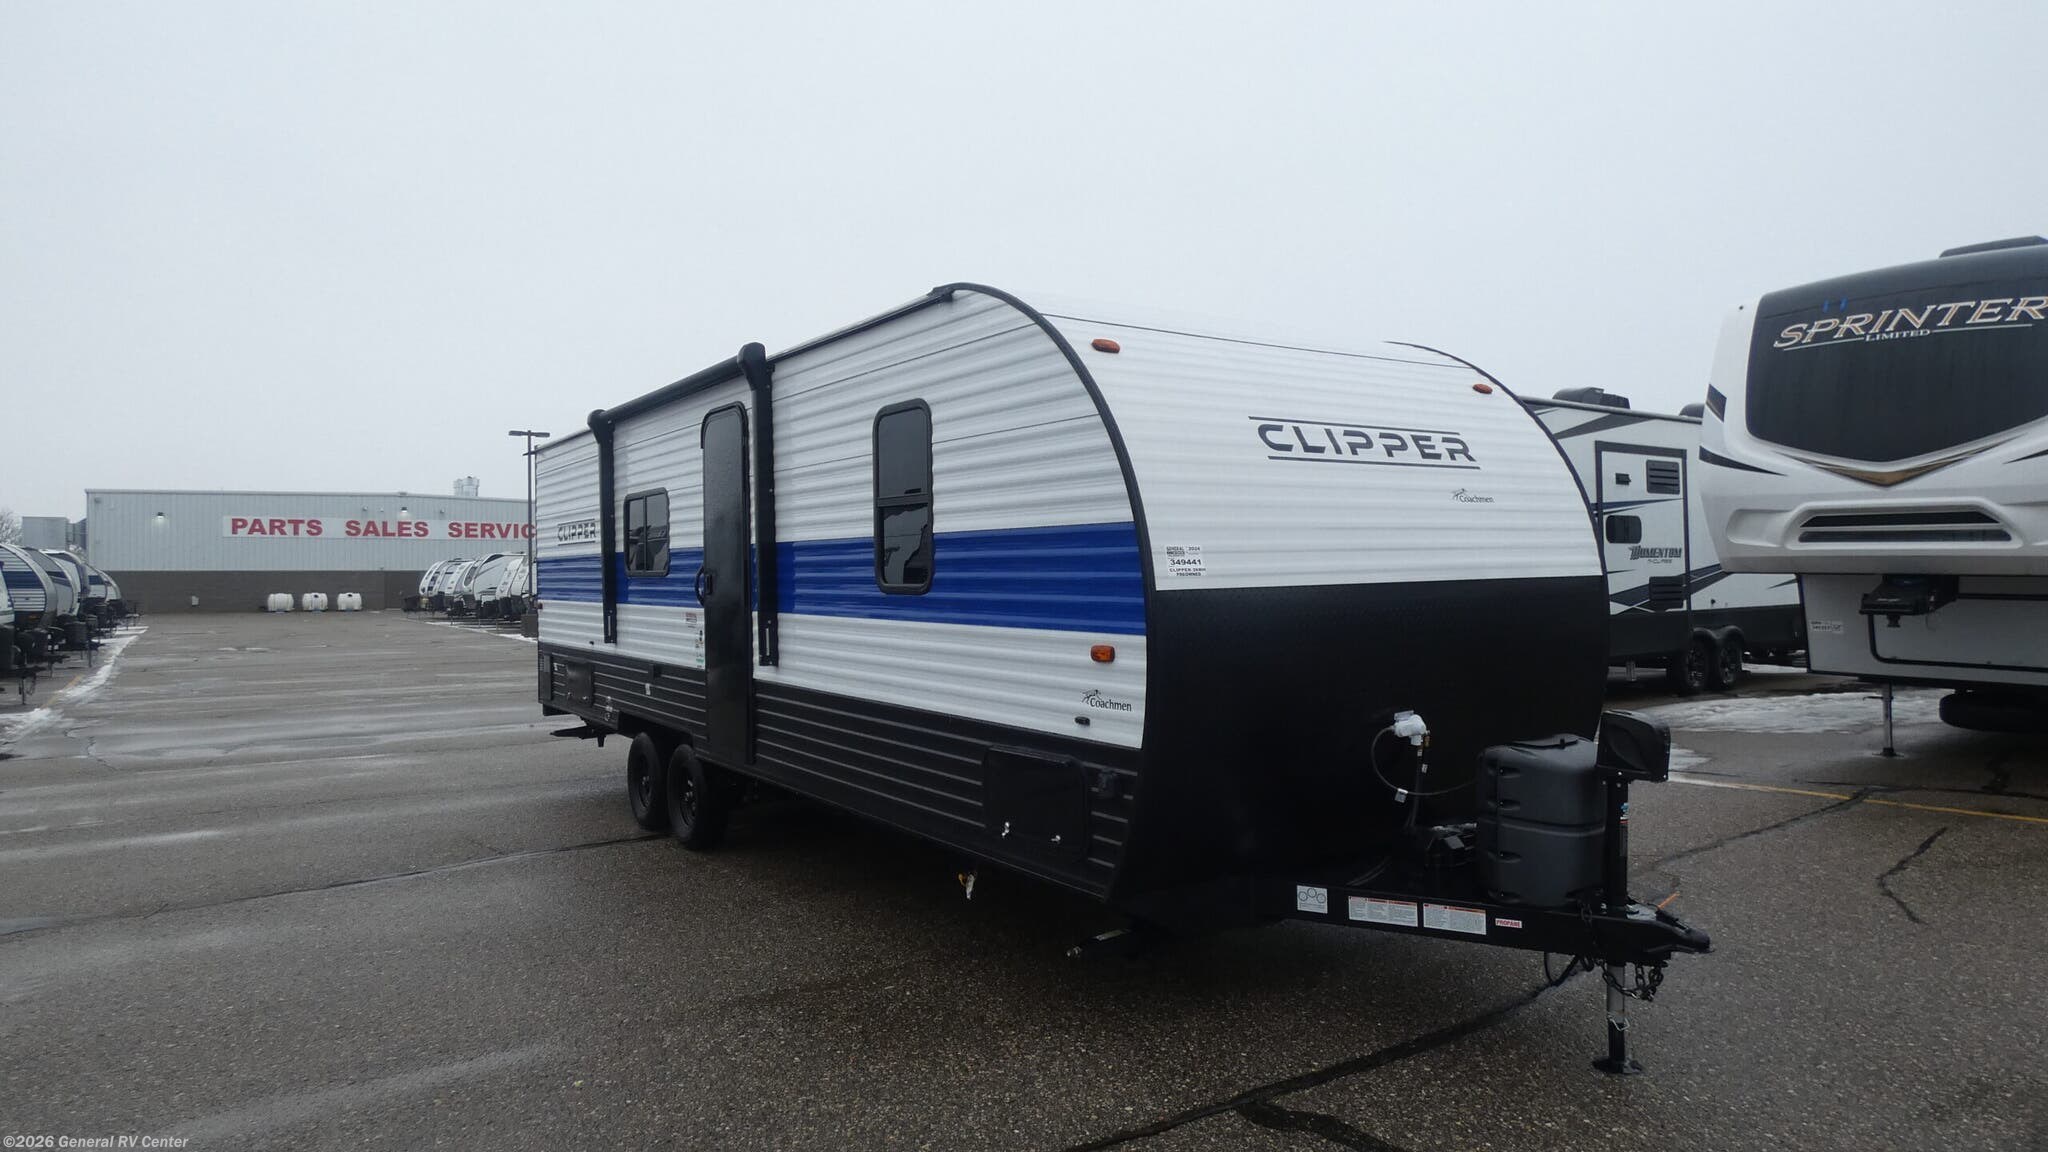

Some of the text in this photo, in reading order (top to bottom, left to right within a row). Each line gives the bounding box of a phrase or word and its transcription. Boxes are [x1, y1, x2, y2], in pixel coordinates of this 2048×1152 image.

[1773, 296, 2048, 348] SPRINTER
[1865, 328, 1931, 342] LIMITED
[1257, 423, 1477, 462] CLIPPER
[1459, 495, 1496, 503] Coachmen
[231, 518, 323, 536] PARTS
[345, 520, 429, 538] SALES
[557, 522, 597, 541] CLIPPER
[1628, 545, 1682, 560] MOMENTUM
[1090, 697, 1132, 712] Coachmen
[1496, 919, 1521, 928] PROPANE
